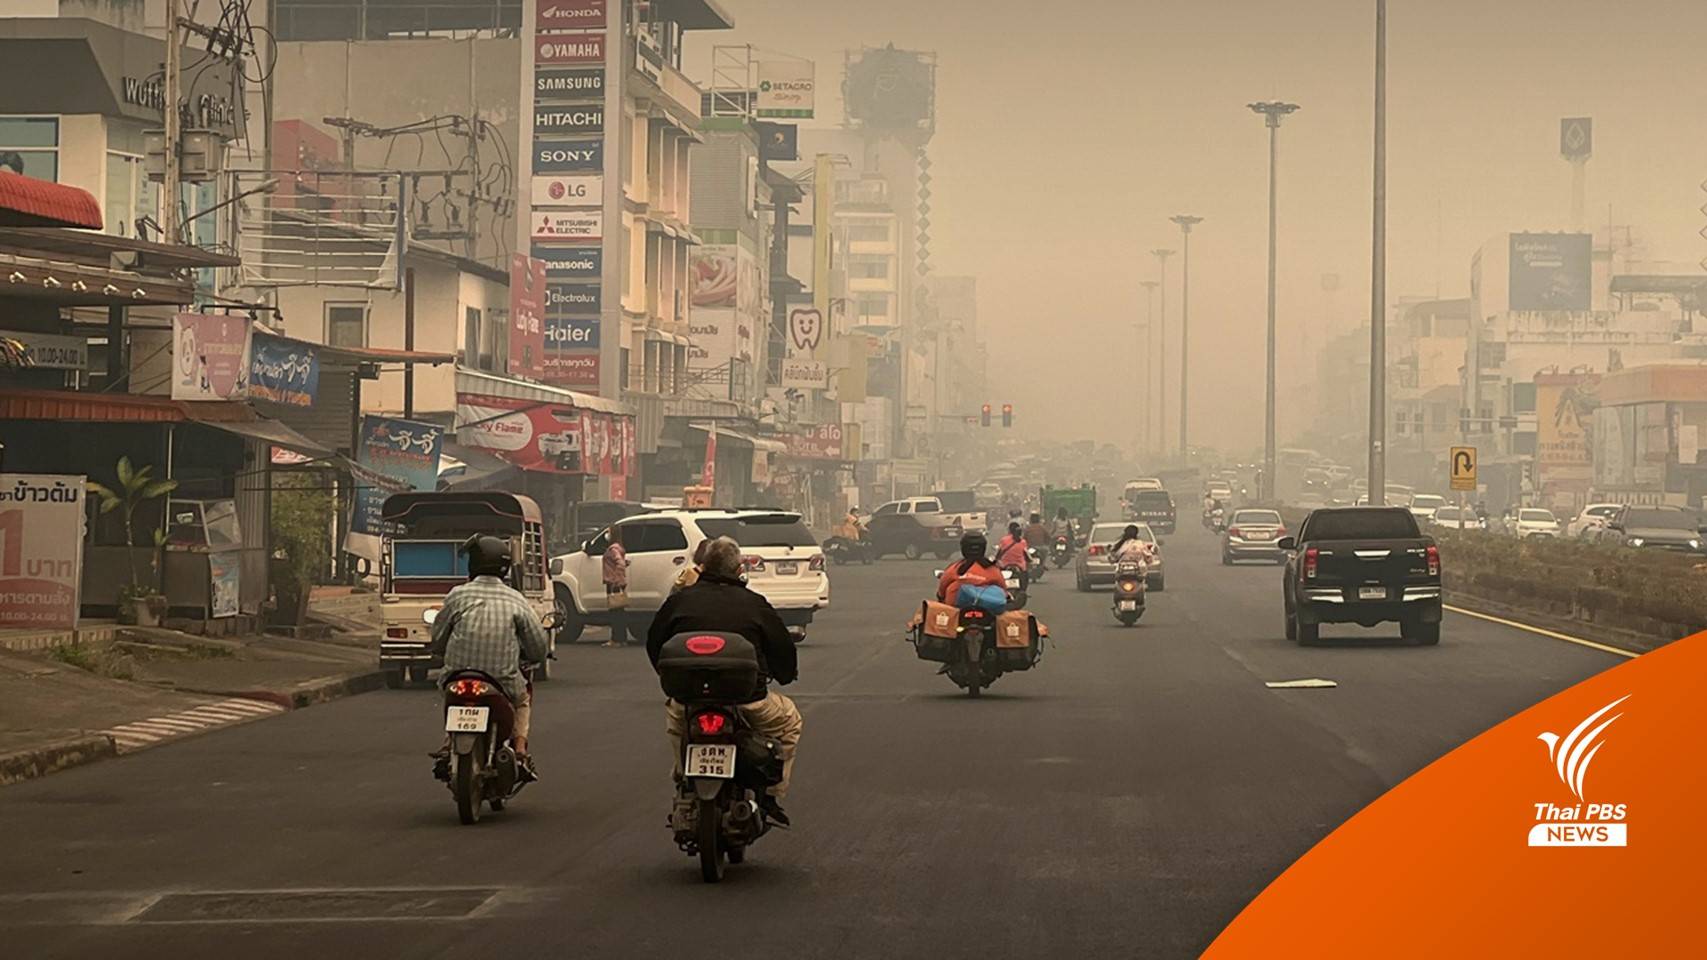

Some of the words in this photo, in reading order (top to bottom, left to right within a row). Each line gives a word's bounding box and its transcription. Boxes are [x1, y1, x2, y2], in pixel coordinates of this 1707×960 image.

[555, 9, 602, 18] HONDA
[554, 43, 600, 57] YAMAHA
[537, 77, 601, 90] SAMSUNG
[536, 112, 602, 126] HITACHI
[540, 150, 594, 162] SONY
[567, 184, 586, 197] LG
[545, 258, 594, 270] anasonic
[551, 293, 596, 303] Electrolux
[495, 422, 524, 434] Flame
[27, 559, 73, 577] บาท
[699, 764, 724, 775] 315
